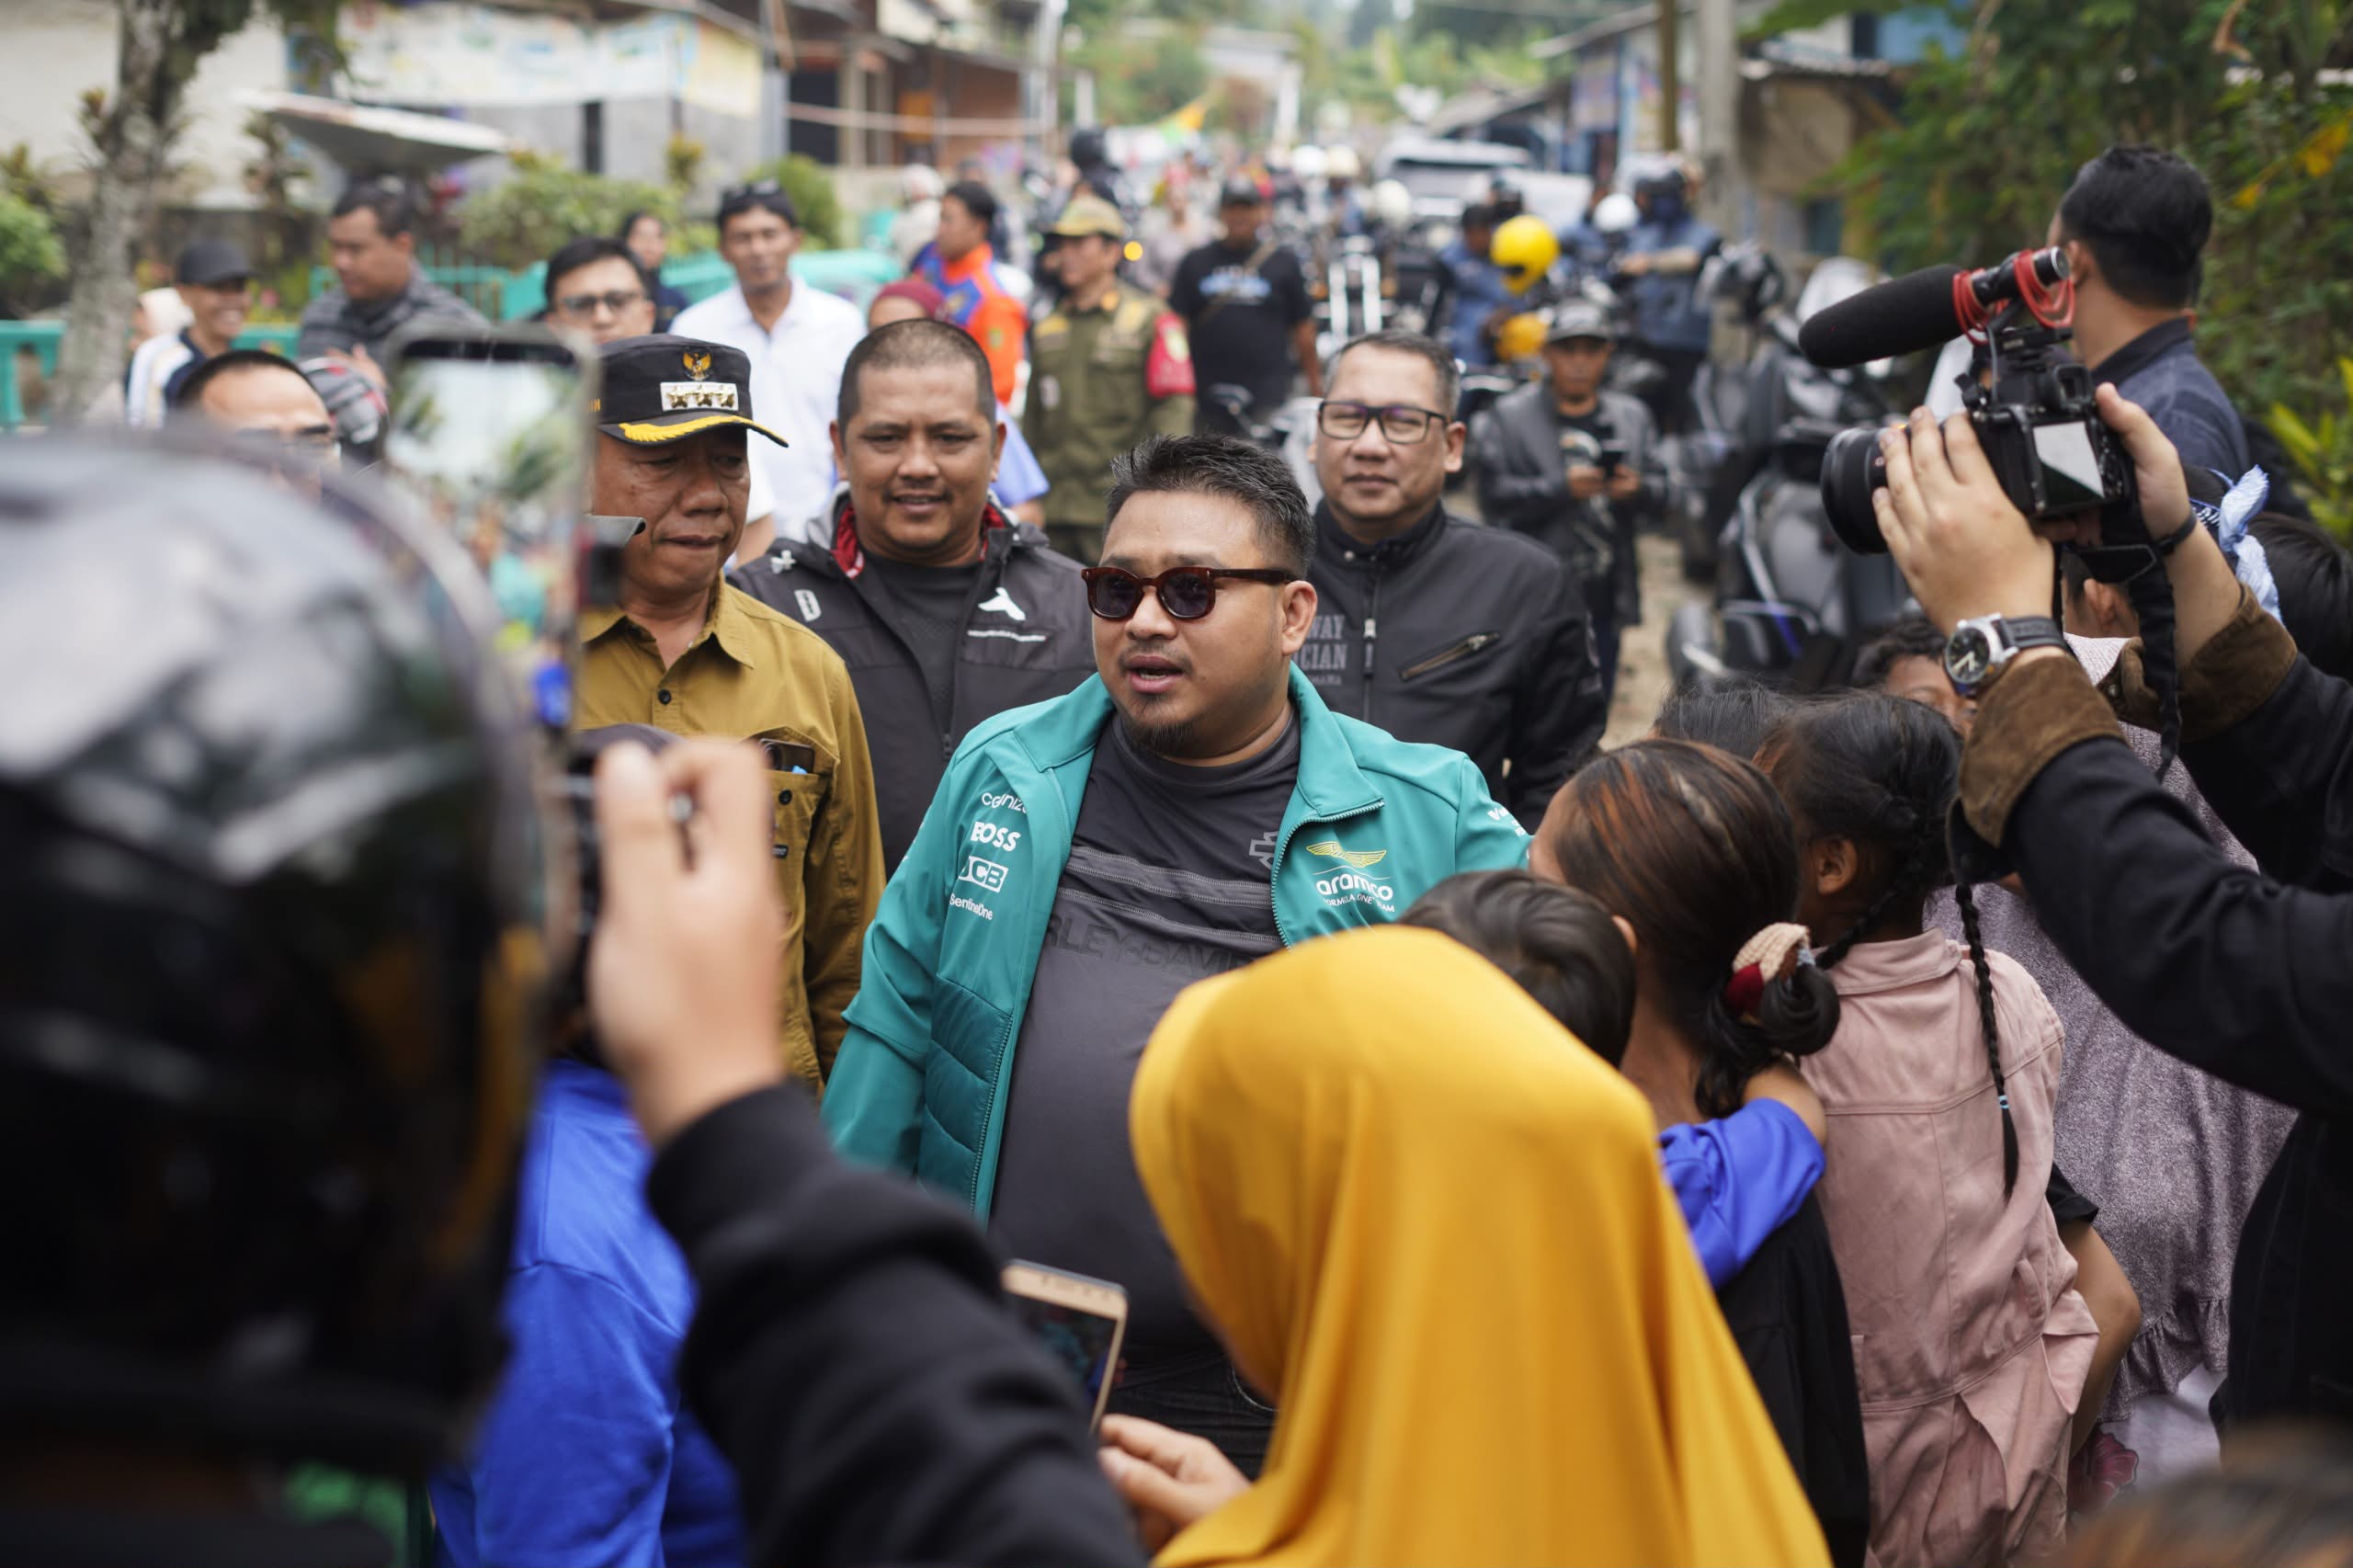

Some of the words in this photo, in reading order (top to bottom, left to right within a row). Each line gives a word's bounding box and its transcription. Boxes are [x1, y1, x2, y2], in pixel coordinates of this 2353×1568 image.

[1306, 615, 1345, 639] WAY
[971, 821, 1021, 852] BOSS
[1315, 873, 1393, 901] aramco
